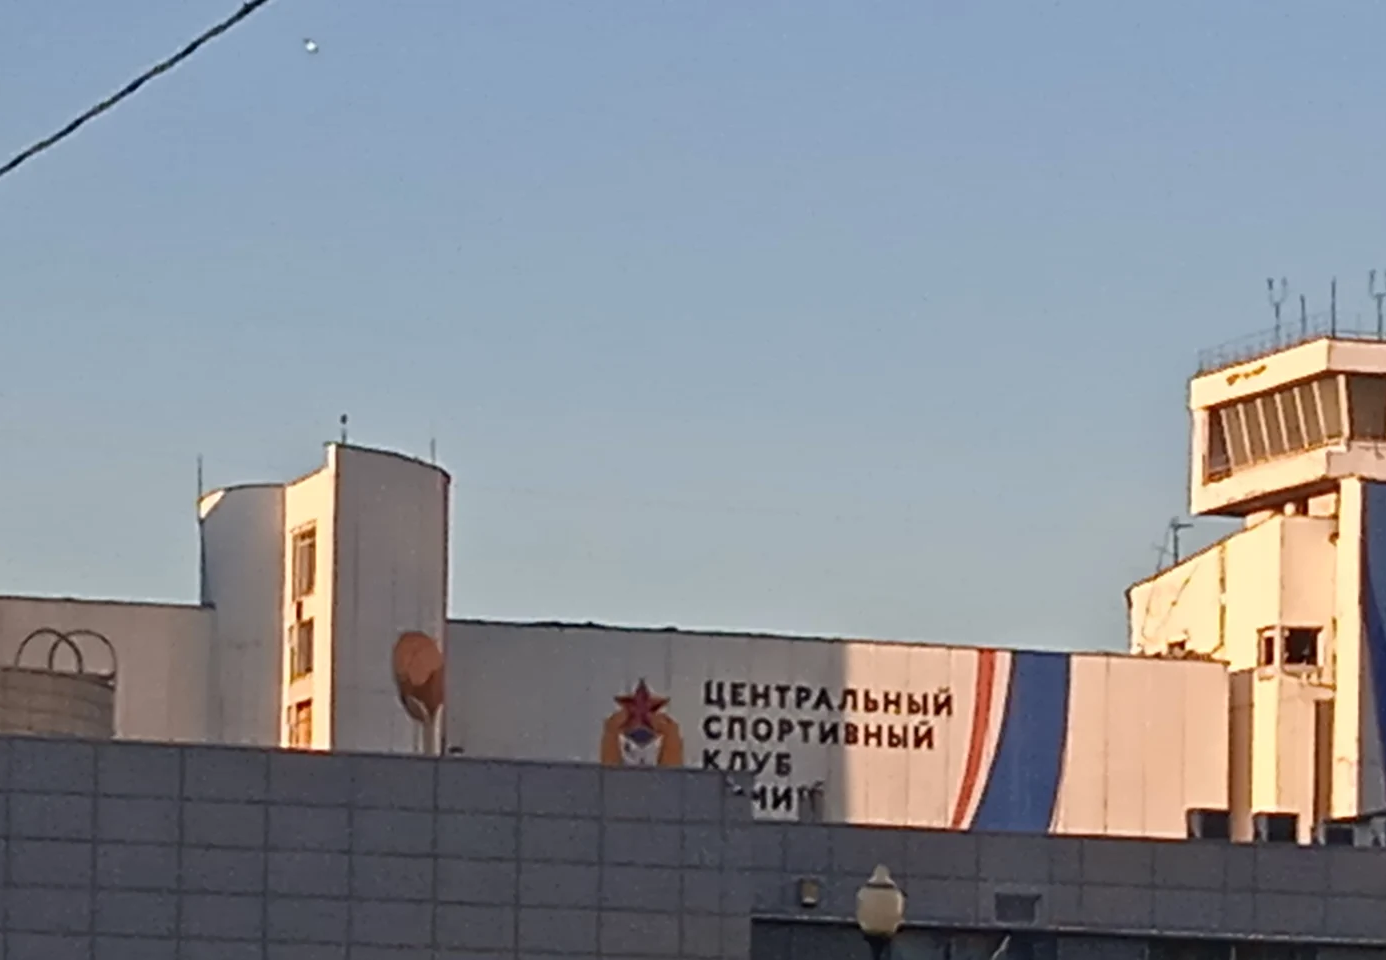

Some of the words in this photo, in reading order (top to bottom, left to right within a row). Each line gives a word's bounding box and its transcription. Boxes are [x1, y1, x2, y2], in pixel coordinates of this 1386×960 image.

[703, 680, 954, 717] ЦЕНТРАЛЬНЫЙ
[702, 715, 935, 750] СПОРТИВНЫЙ
[702, 749, 793, 777] КЛУБ
